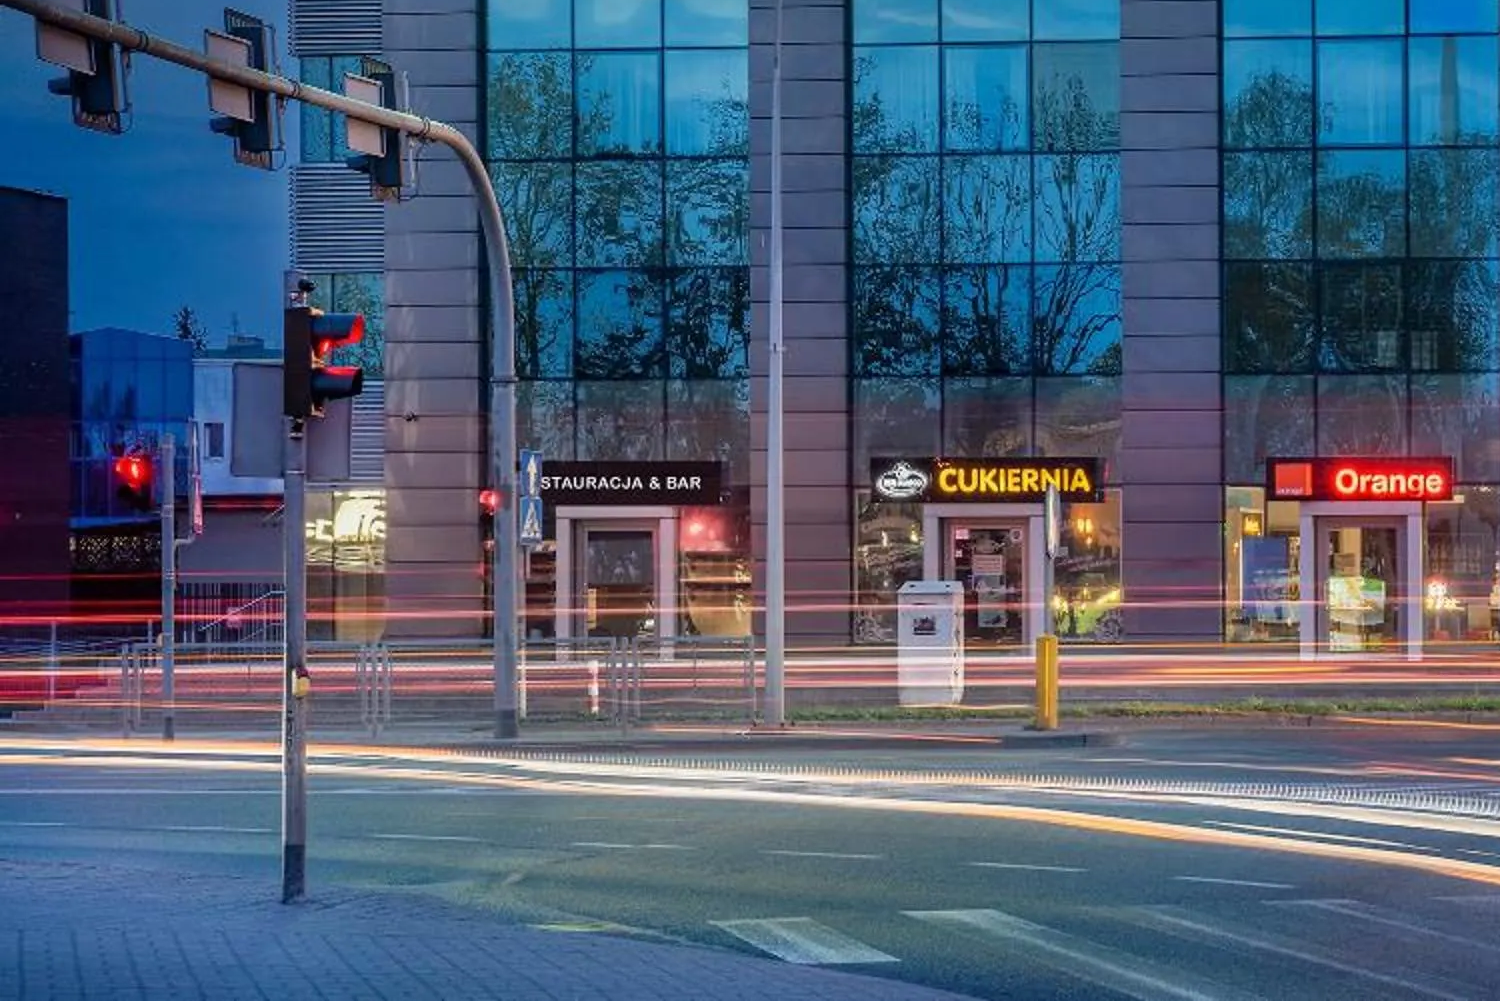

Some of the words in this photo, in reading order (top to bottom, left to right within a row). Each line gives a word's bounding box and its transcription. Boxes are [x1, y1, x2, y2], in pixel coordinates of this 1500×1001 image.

[540, 476, 643, 490] STAURACJA
[649, 476, 661, 490] &
[666, 476, 702, 490] BAR
[938, 467, 1091, 493] CUKIERNIA
[1334, 468, 1444, 497] Orange
